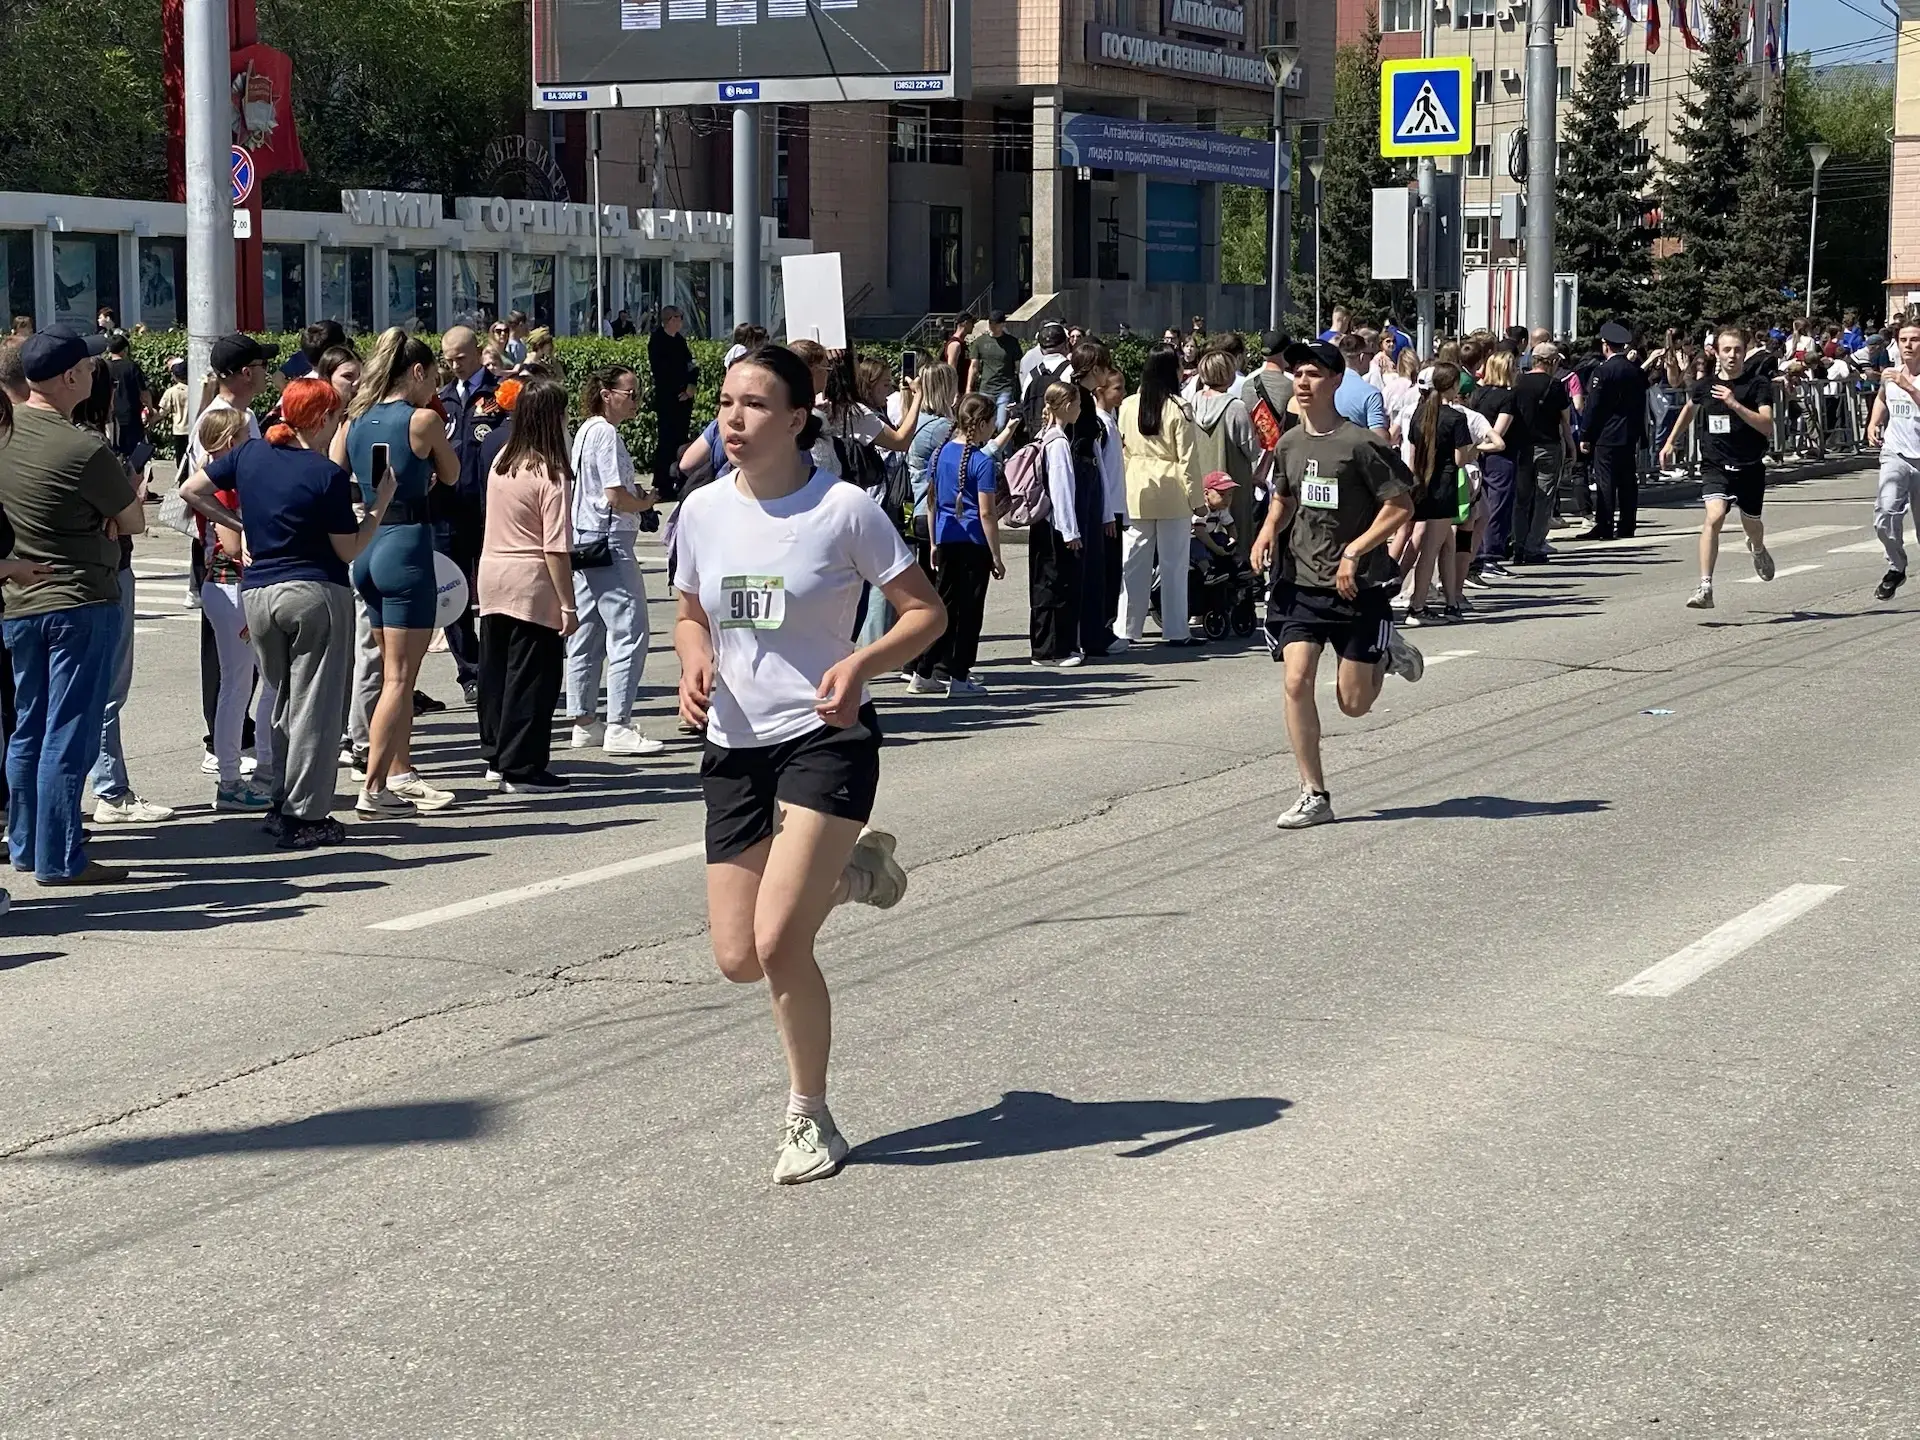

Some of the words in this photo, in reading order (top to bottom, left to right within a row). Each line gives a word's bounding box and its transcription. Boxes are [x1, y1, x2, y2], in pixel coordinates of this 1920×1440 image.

[1171, 0, 1244, 35] АЛТАЙСКИЙ
[1101, 32, 1223, 78] ГОСУДАРСТВЕННЫЙ
[1224, 55, 1303, 90] УНИВЕРСЕТ
[735, 87, 753, 95] Russ
[915, 80, 941, 89] 229-922
[1103, 125, 1145, 142] Алтайский
[1145, 131, 1208, 151] государственный
[1208, 141, 1250, 157] университет
[1114, 150, 1123, 161] по
[1124, 152, 1179, 167] приоритетным
[1180, 157, 1230, 172] направлениям
[1230, 165, 1270, 179] подготовки!
[352, 189, 442, 229] ИМИ
[1892, 404, 1910, 415] 1009
[1307, 484, 1330, 502] 866
[731, 590, 772, 619] 967
